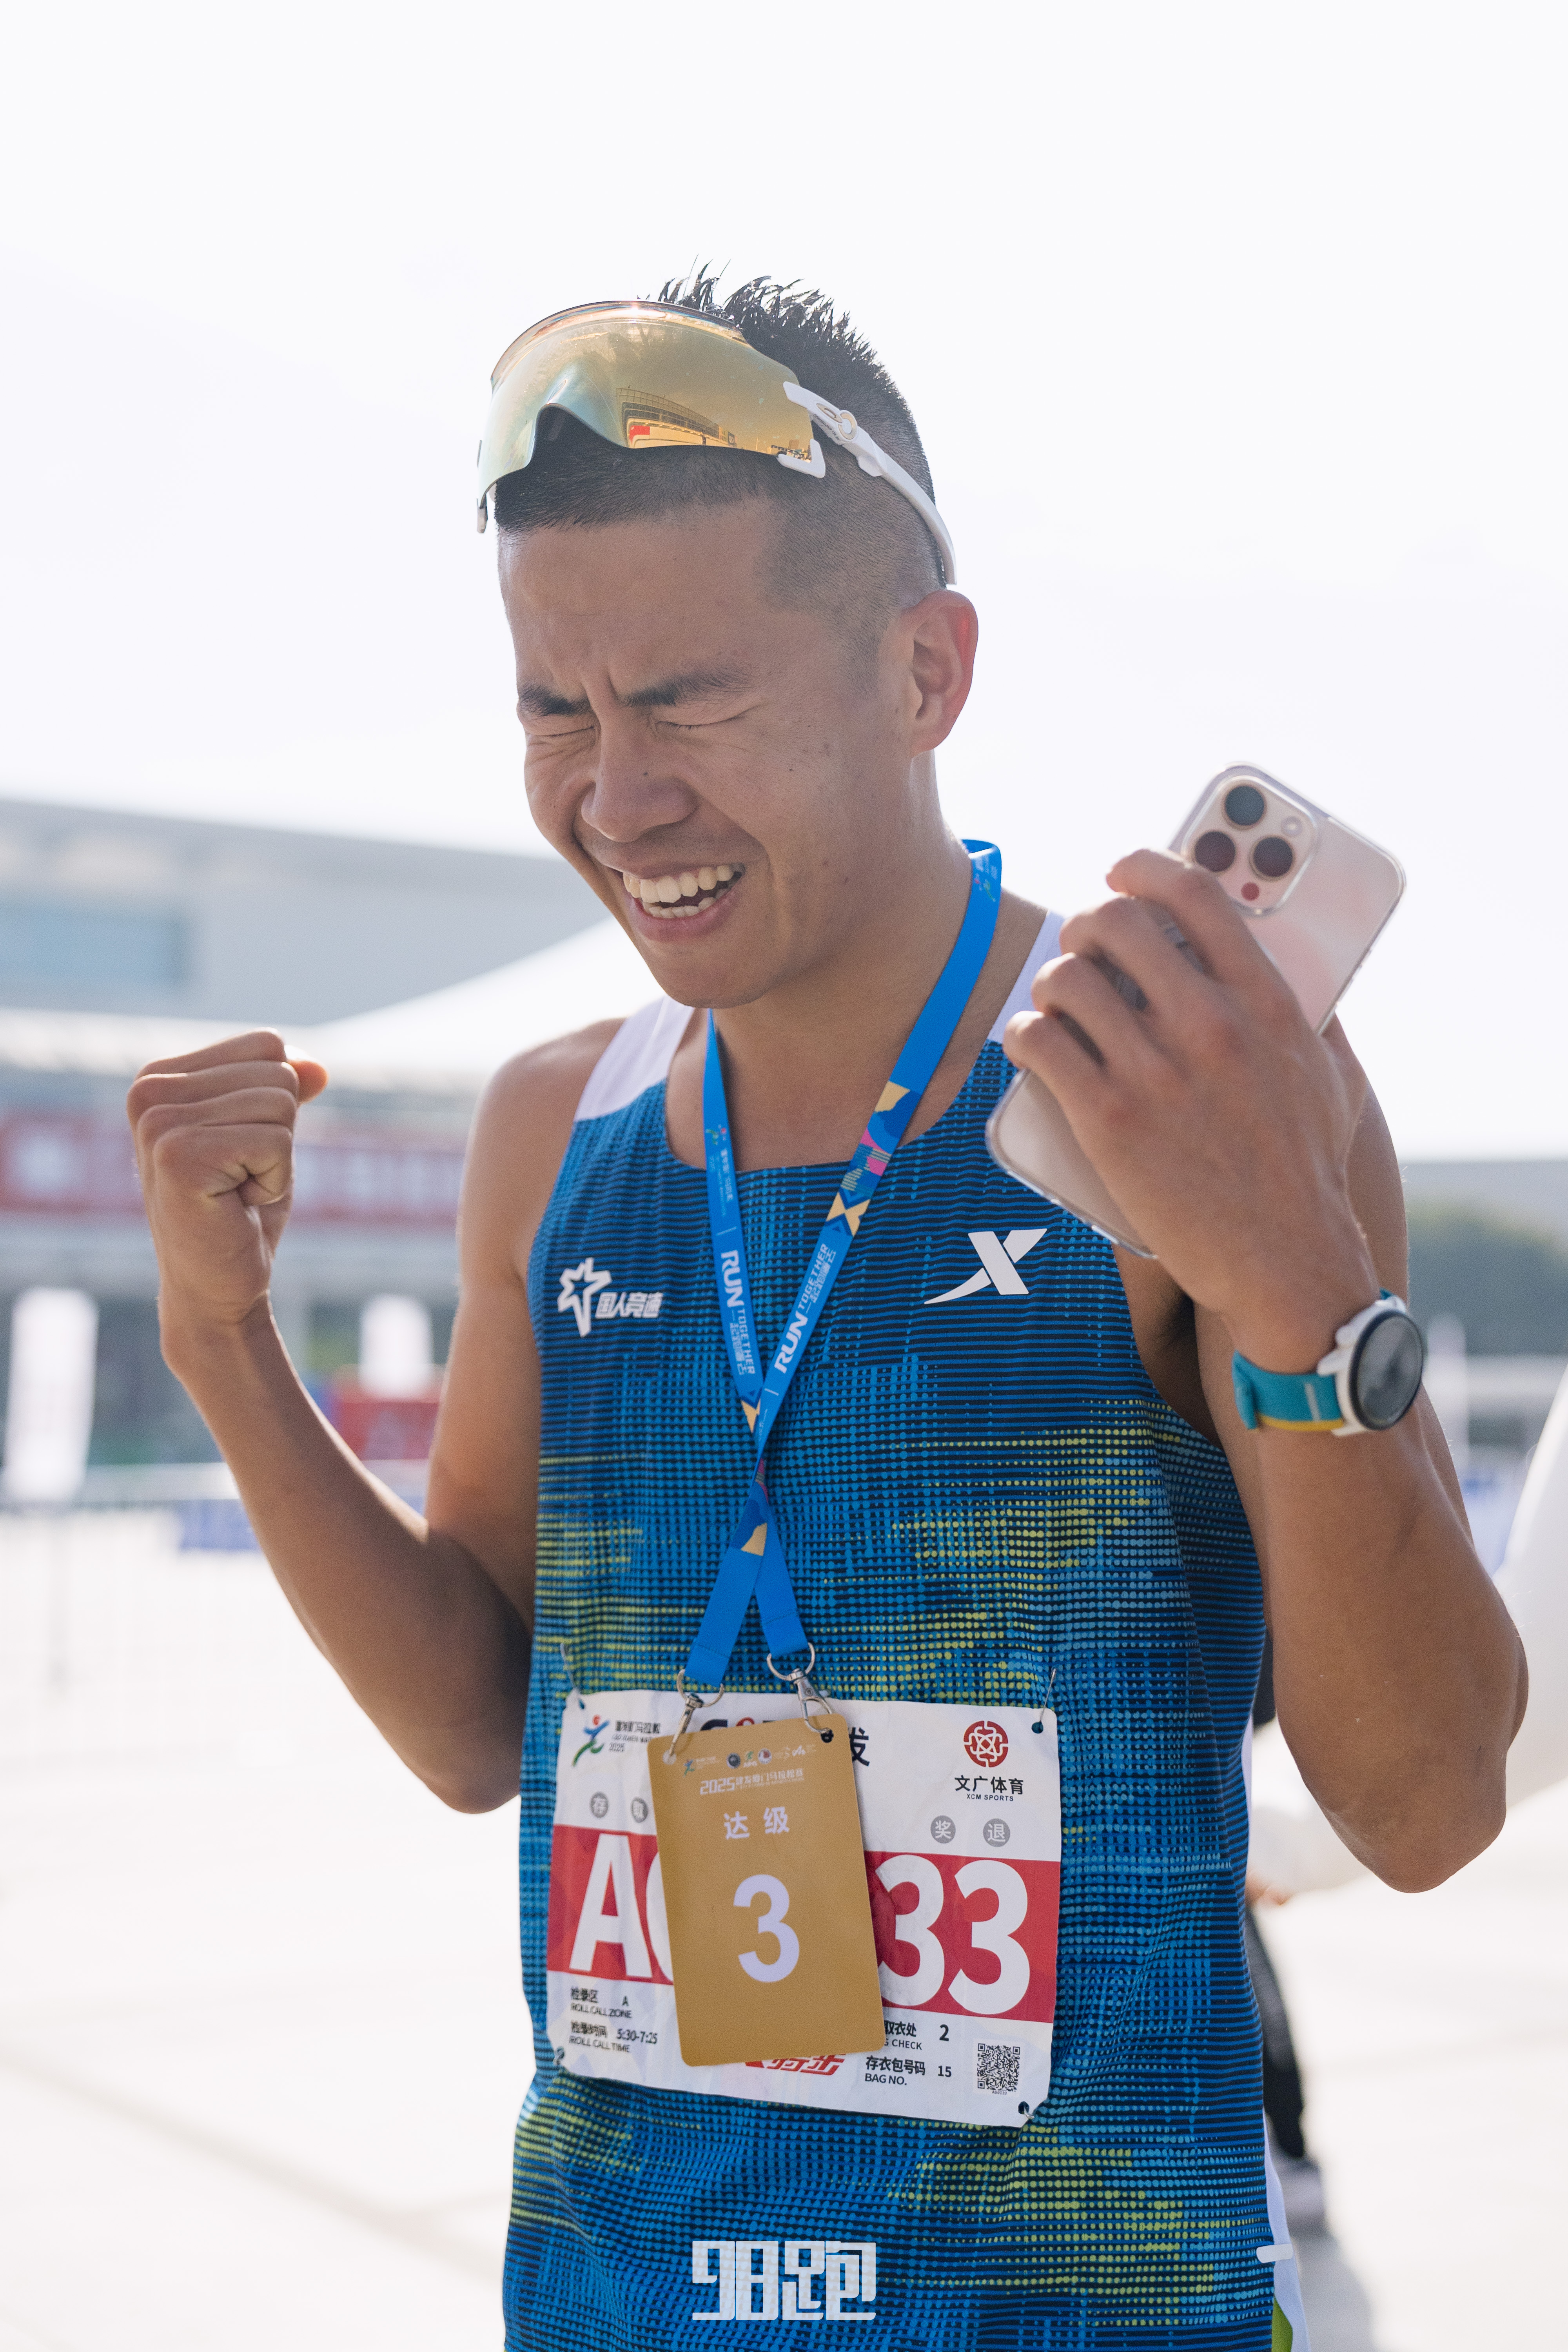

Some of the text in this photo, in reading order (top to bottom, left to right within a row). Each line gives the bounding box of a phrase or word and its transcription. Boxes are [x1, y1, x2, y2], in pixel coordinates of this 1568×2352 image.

[720, 1250, 744, 1308] RUN
[738, 1308, 755, 1374] TOGETHER
[774, 1312, 808, 1374] RUN
[799, 1243, 829, 1310] TOGETHER
[955, 1775, 1024, 1795] 文广体育
[733, 1874, 800, 1983] 3
[570, 2002, 633, 2018] ROLL CALL ZONE
[622, 1996, 629, 2006] A
[939, 2024, 949, 2042] 2
[569, 2035, 631, 2053] ROLL CALL TIME
[891, 2039, 922, 2050] CHECK
[866, 2055, 952, 2078] 存衣包号码 15
[865, 2073, 907, 2085] BAG NO.
